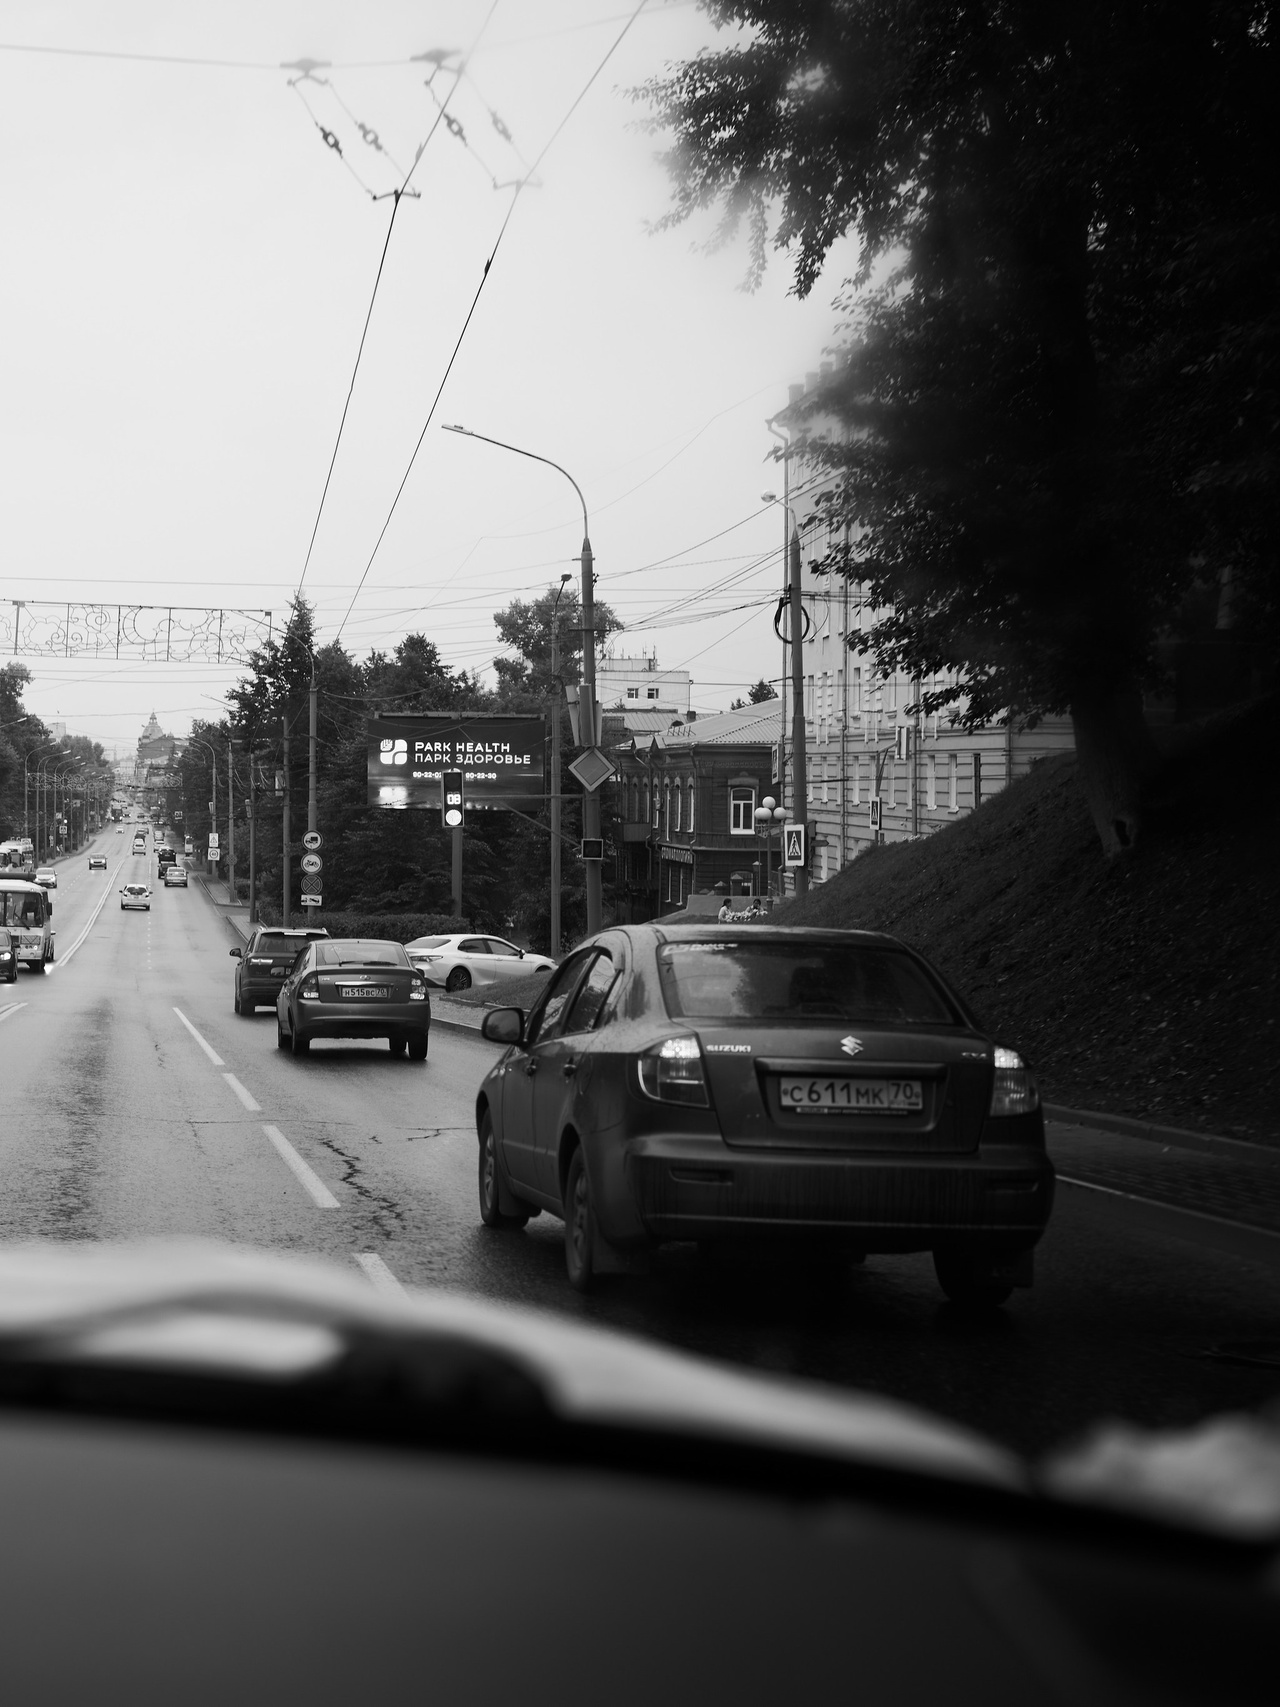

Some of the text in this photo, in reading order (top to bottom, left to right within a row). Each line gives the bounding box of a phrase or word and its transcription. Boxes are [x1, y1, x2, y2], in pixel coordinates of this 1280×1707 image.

[415, 742, 510, 753] PARK HEALTH
[415, 753, 531, 765] ПАРК ЗДОРОВЬЕ
[446, 794, 461, 805] 08
[706, 1044, 751, 1053] SUZUKI
[790, 1081, 914, 1104] С611МК 70
